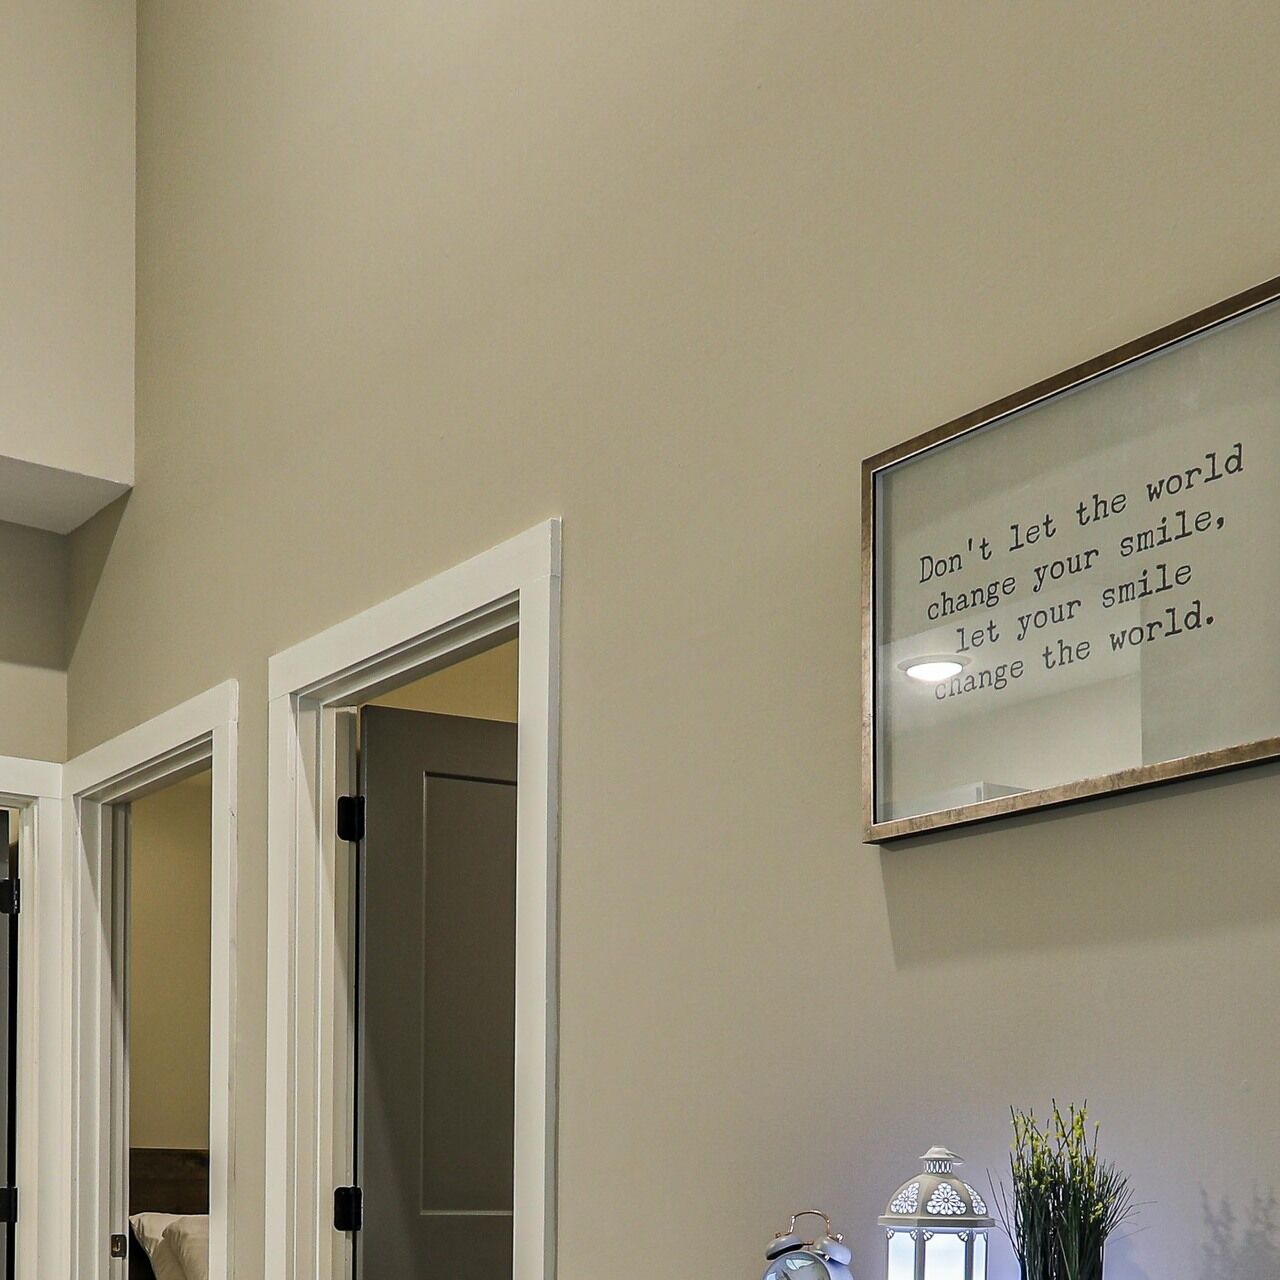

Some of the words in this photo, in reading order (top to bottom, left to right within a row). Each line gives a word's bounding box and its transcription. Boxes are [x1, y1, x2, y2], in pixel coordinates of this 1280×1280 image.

[919, 537, 993, 584] Don't
[1008, 512, 1057, 553] let
[1075, 493, 1127, 527] the
[1145, 441, 1244, 503] world
[926, 573, 1017, 621] change
[1032, 547, 1100, 593] your
[1119, 510, 1226, 558] smile,
[933, 656, 1025, 701] change
[1041, 638, 1091, 671] the
[1108, 599, 1216, 653] world.
[955, 619, 1000, 654] let
[1017, 598, 1082, 642] your
[1101, 563, 1193, 609] smile
